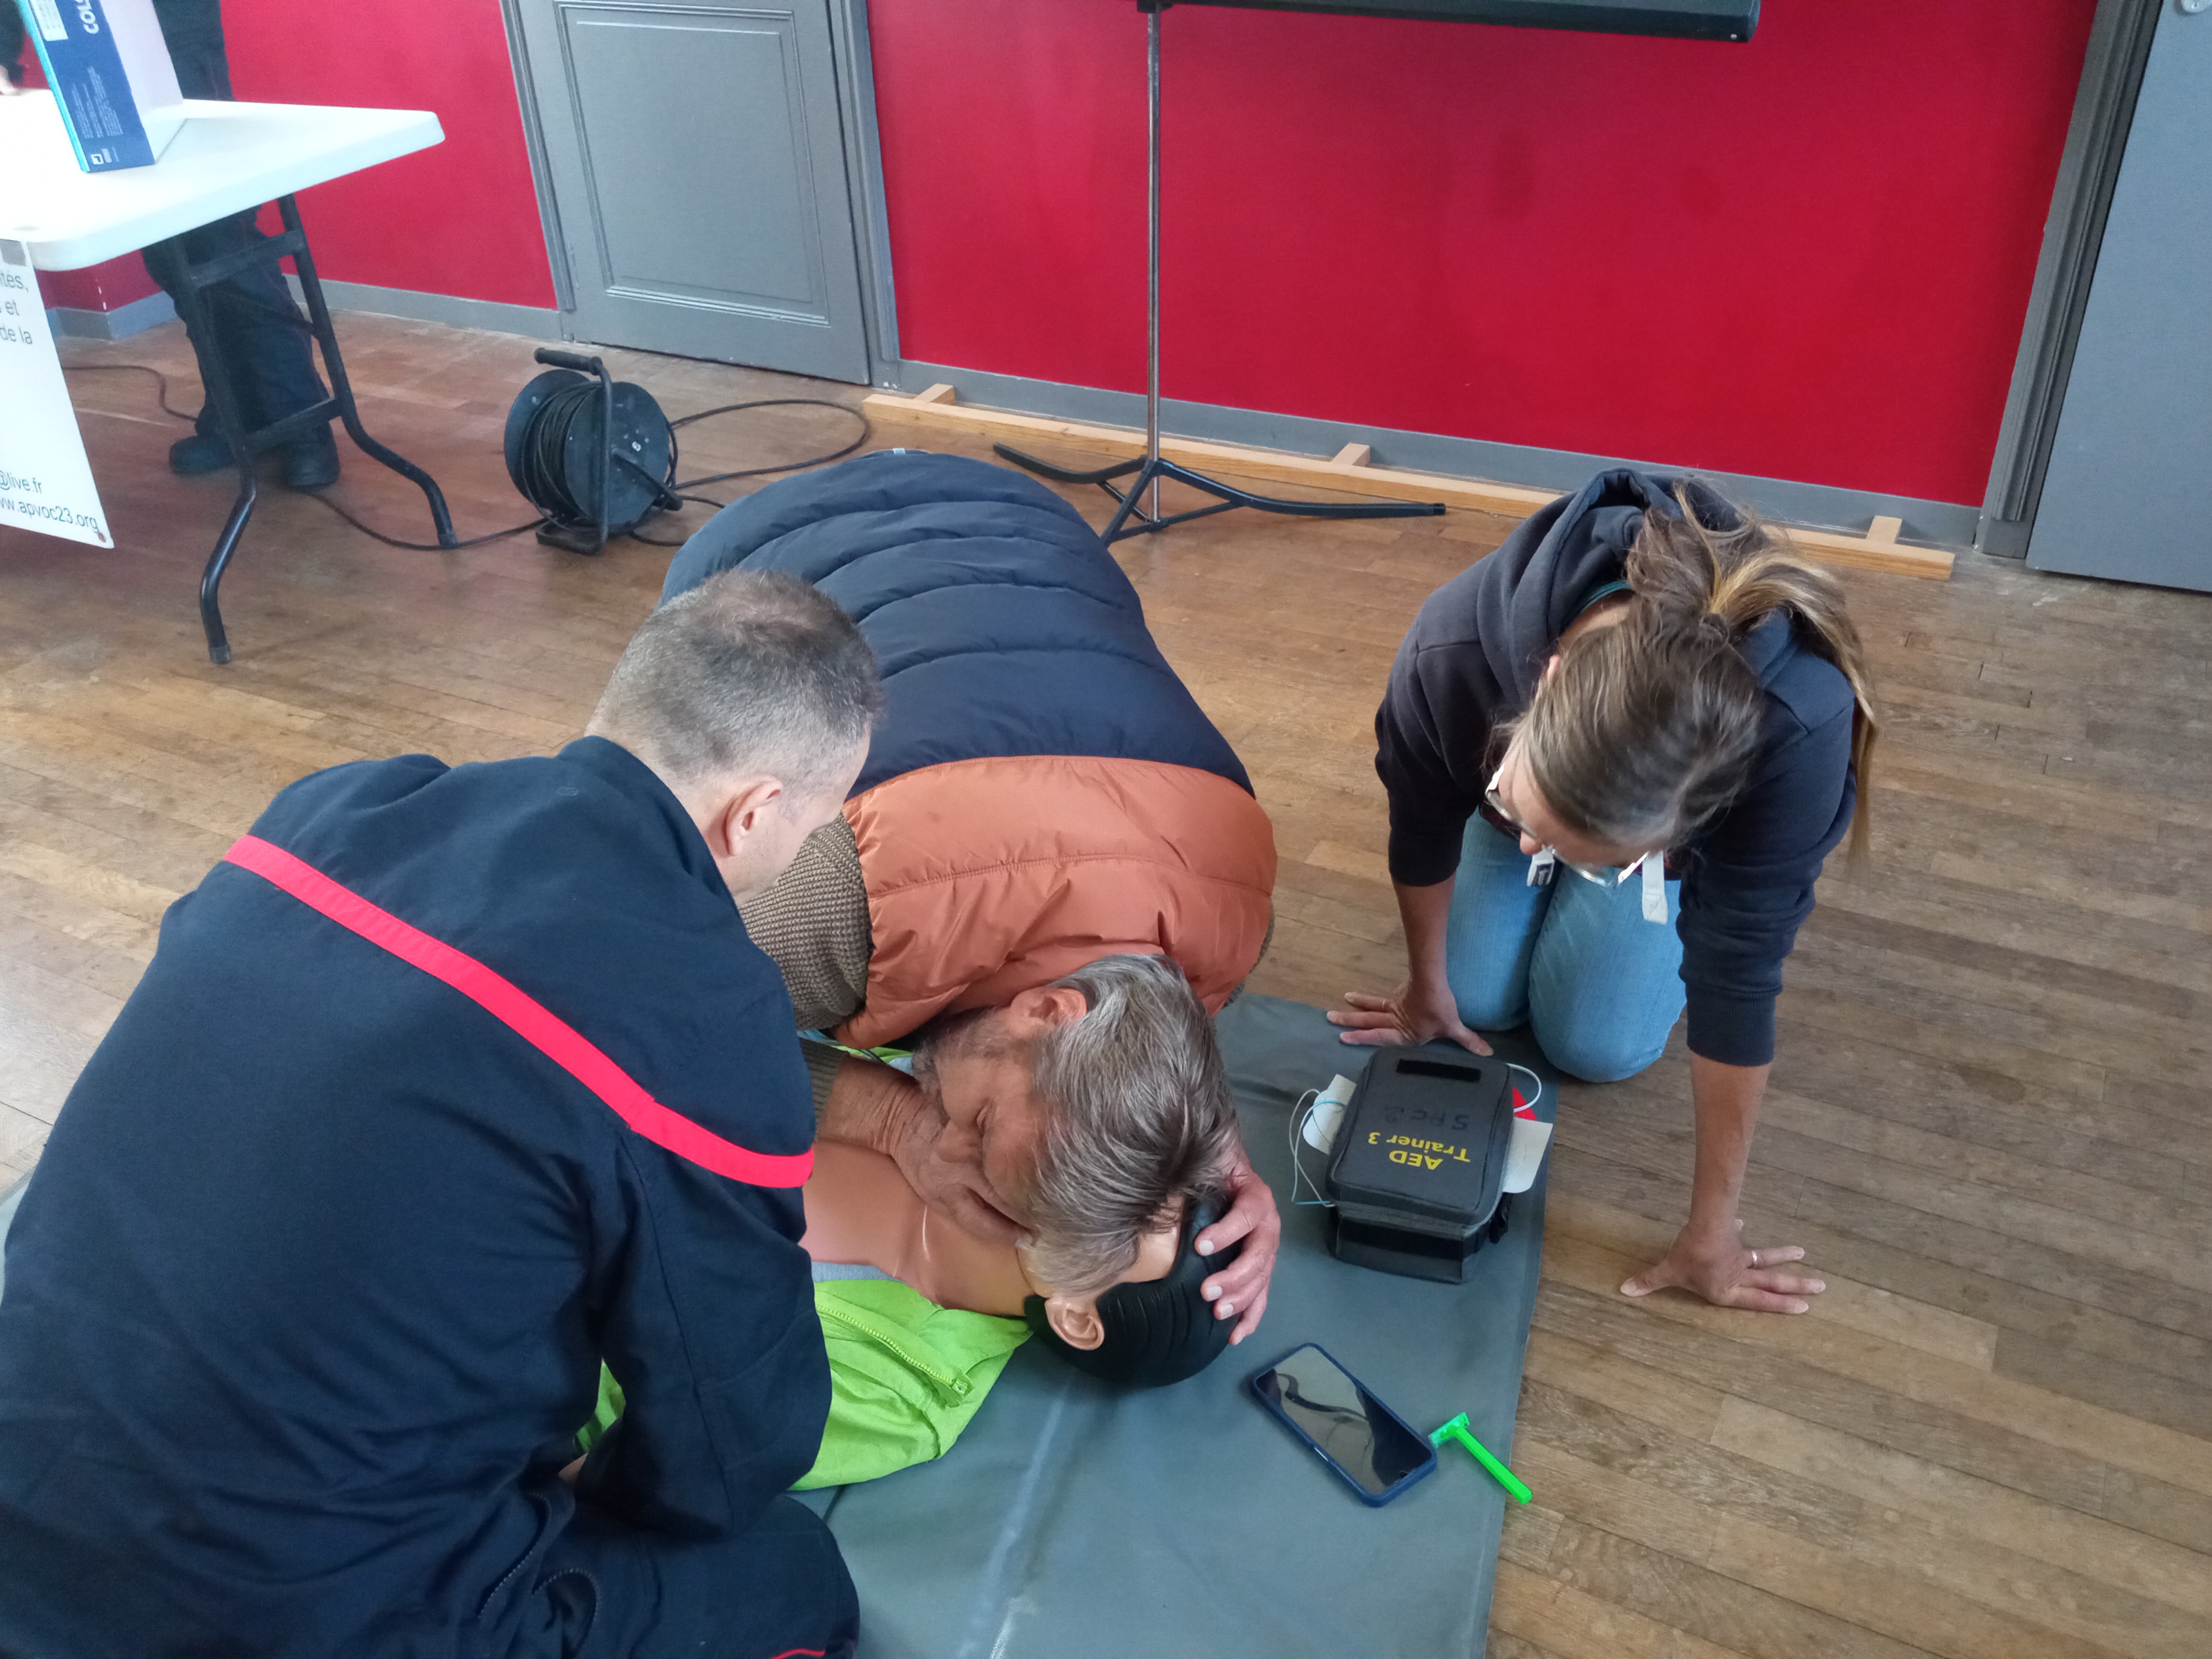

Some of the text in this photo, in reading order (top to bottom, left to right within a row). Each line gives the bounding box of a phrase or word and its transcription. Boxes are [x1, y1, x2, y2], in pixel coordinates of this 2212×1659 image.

[75, 0, 99, 34] COL
[5, 299, 19, 316] et
[18, 326, 32, 345] la
[1368, 1132, 1470, 1162] Trainer 3
[1389, 1150, 1443, 1170] AED
